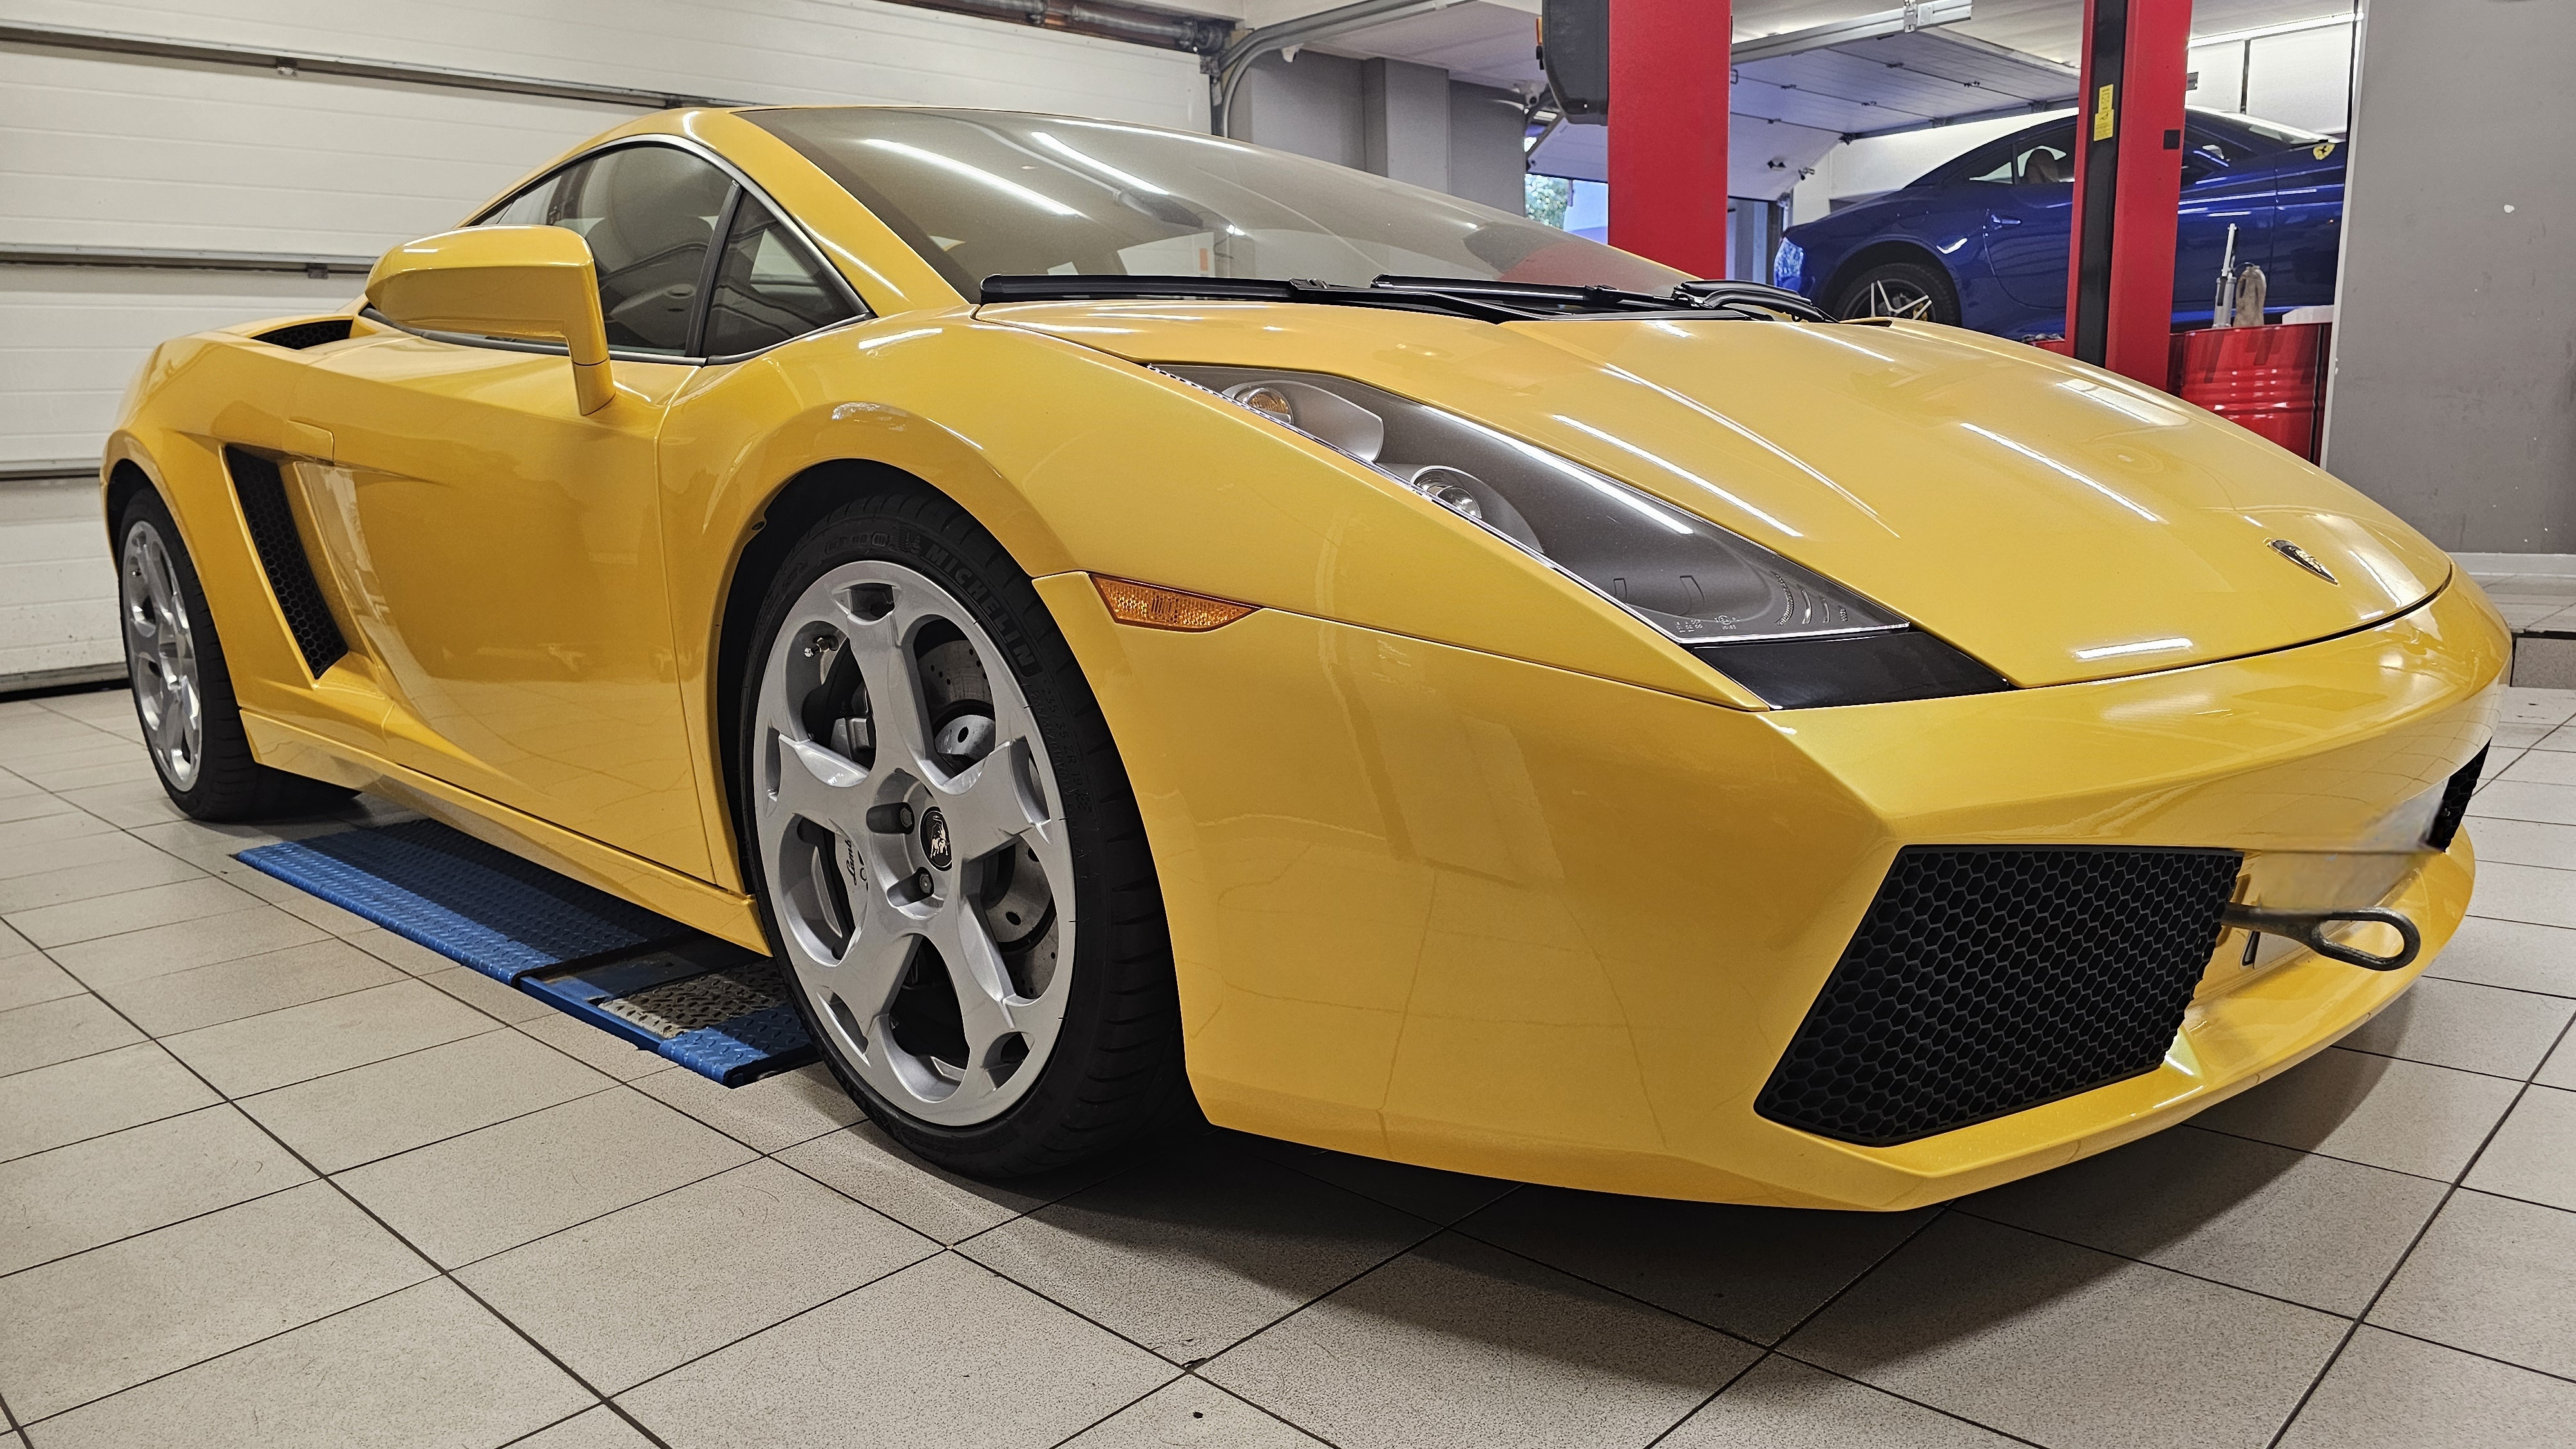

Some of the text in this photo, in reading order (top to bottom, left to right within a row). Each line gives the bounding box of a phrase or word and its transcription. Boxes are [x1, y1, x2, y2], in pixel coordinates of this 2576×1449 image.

[926, 544, 1036, 667] MICHELIN
[1041, 687, 1070, 739] 235/35
[1063, 744, 1078, 765] ZR
[1071, 771, 1083, 786] 19
